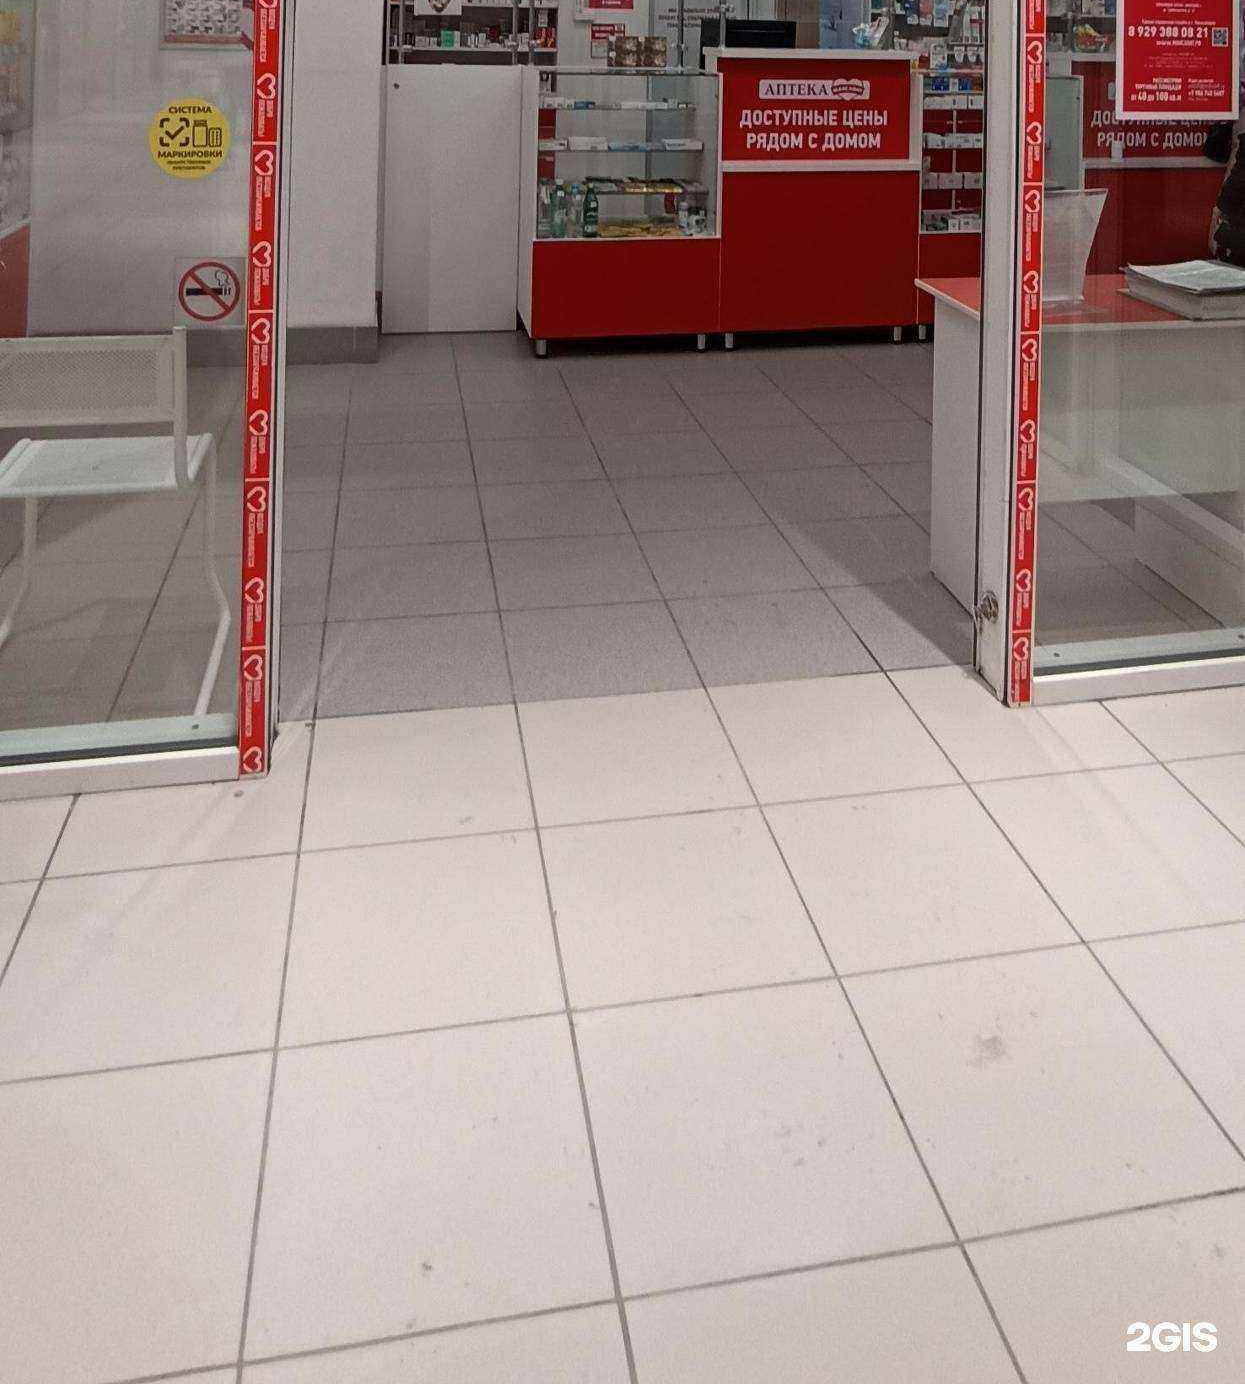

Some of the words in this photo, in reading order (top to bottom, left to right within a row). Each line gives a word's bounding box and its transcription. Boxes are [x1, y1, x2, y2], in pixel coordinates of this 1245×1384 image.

[1128, 26, 1135, 37] 8
[1137, 26, 1157, 37] 929
[1197, 27, 1208, 38] 21
[764, 83, 828, 96] АПТЕКА
[169, 106, 212, 114] СИСТЕМА
[740, 110, 837, 128] ДОСТУПНЫЕ
[843, 110, 887, 128] ЦЕНЫ
[747, 133, 803, 151] РЯДОМ
[809, 133, 818, 148] С
[822, 133, 881, 151] ДОМОМ
[1098, 131, 1146, 149] РЯДОМ
[1151, 132, 1159, 147] С
[158, 150, 223, 158] МАРКИРОВКИ
